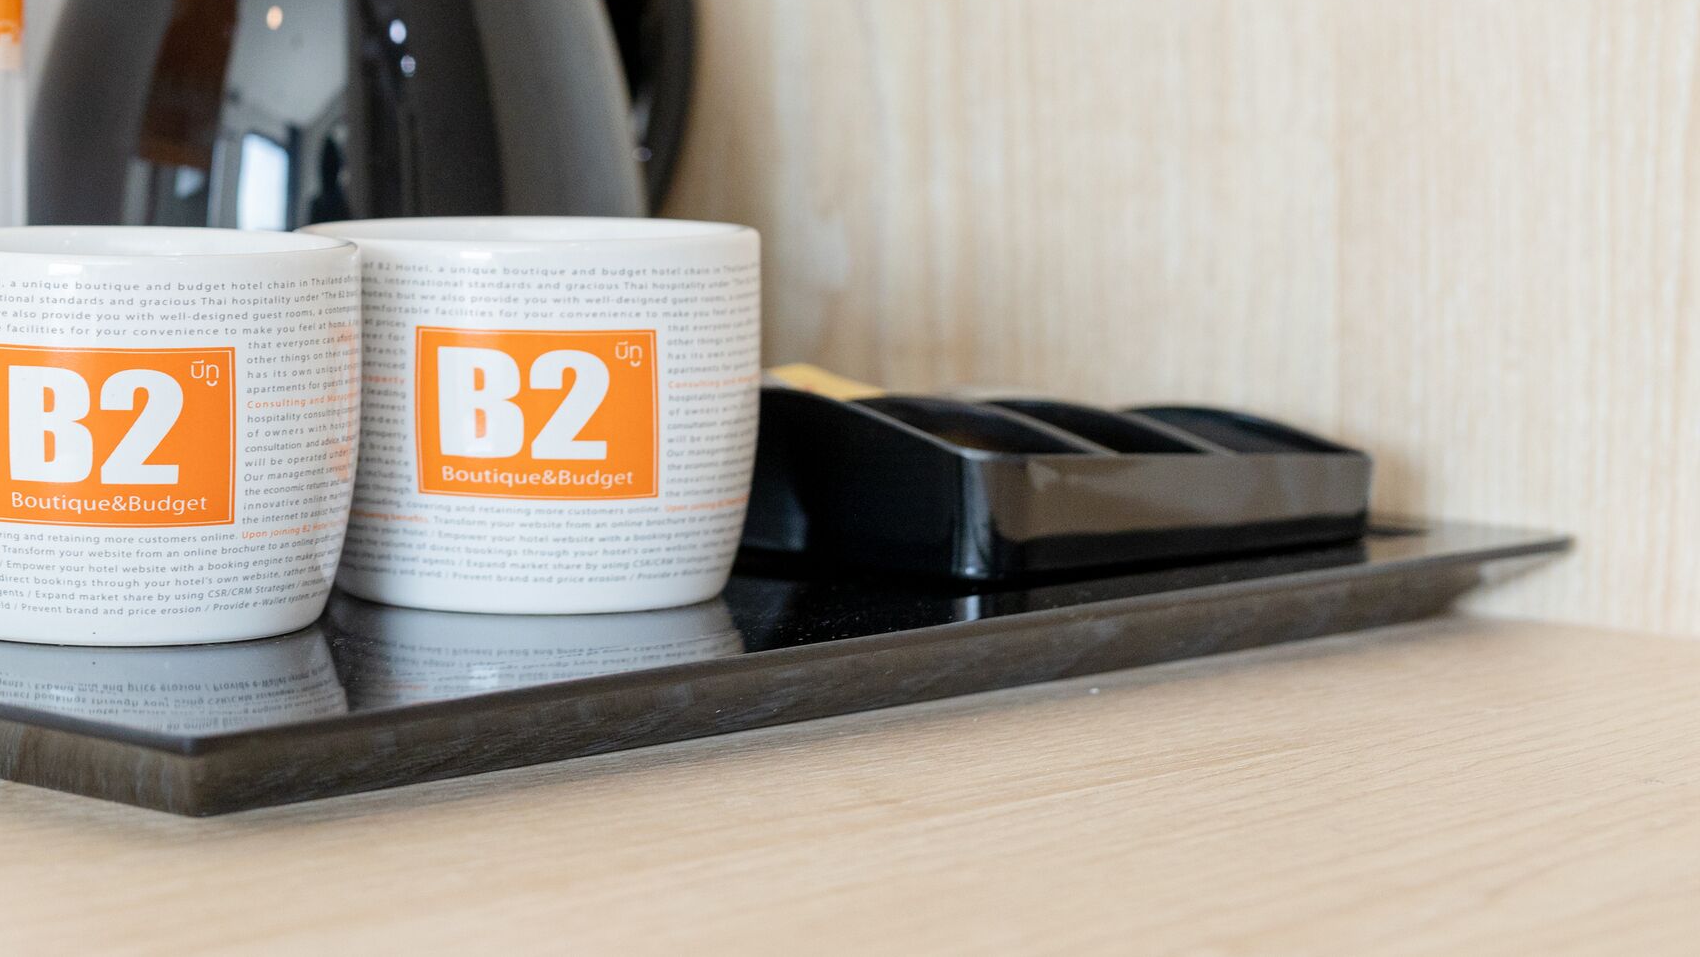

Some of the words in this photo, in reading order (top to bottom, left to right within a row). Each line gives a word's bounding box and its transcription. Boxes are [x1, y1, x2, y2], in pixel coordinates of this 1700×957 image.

[22, 280, 68, 291] unique
[75, 281, 140, 293] boutique
[146, 282, 172, 290] and
[177, 282, 226, 293] budget
[231, 280, 263, 290] hotel
[267, 280, 296, 289] chain
[299, 278, 308, 287] in
[39, 295, 104, 305] standards
[110, 297, 135, 306] and
[139, 297, 196, 308] gracious
[202, 296, 227, 305] Thai
[232, 295, 291, 307] hospitality
[294, 293, 319, 302] under
[12, 309, 37, 318] also
[42, 311, 92, 321] provide
[96, 314, 120, 323] you
[126, 312, 154, 321] with
[160, 311, 249, 322] well-designed
[252, 310, 282, 322] guest
[6, 323, 65, 334] facilities
[70, 326, 90, 335] for
[96, 329, 126, 338] your
[133, 327, 220, 336] convenience
[224, 326, 238, 335] to
[242, 325, 273, 335] make
[276, 326, 296, 336] you
[299, 322, 316, 331] feel
[248, 340, 272, 350] that
[276, 339, 321, 349] everyone
[247, 355, 276, 364] other
[281, 353, 311, 363] things
[615, 341, 642, 367] บีทู
[191, 360, 219, 386] บีทู
[248, 371, 271, 379] has
[273, 369, 288, 378] its
[247, 382, 306, 396] apartments
[247, 397, 306, 409] Consulting
[438, 346, 610, 460] B2
[9, 365, 183, 484] B2
[247, 412, 302, 425] hospitality
[245, 441, 302, 452] consultation
[245, 457, 265, 467] will
[270, 457, 283, 466] be
[287, 452, 328, 466] operated
[244, 473, 264, 482] Our
[267, 466, 325, 480] management
[442, 466, 633, 489] Boutique&Budget
[11, 492, 207, 515] Boutique&Budget
[243, 498, 300, 510] innovative
[242, 516, 259, 525] the
[262, 511, 299, 523] internet
[23, 532, 44, 541] and
[47, 534, 101, 546] retaining
[138, 535, 198, 544] customers
[200, 532, 238, 542] online.
[242, 531, 267, 541] Upon
[271, 527, 299, 539] joining
[3, 545, 56, 556] Transform
[58, 550, 84, 559] your
[88, 549, 133, 558] website
[136, 549, 163, 558] from
[183, 548, 218, 557] online
[221, 544, 266, 554] brochure
[268, 542, 278, 550] to
[6, 560, 56, 572] Empower
[59, 565, 84, 574] your
[88, 564, 118, 573] hotel
[122, 564, 167, 573] website
[170, 563, 195, 572] with
[207, 560, 250, 570] booking
[252, 556, 283, 568] engine
[34, 576, 87, 589] bookings
[92, 578, 140, 589] through
[144, 580, 171, 590] your
[175, 576, 213, 586] hotel's
[216, 576, 239, 584] own
[35, 590, 76, 602] Expand
[79, 592, 119, 601] market
[123, 593, 154, 601] share
[157, 593, 171, 603] by
[174, 591, 205, 602] using
[21, 602, 64, 613] Prevent
[66, 606, 99, 615] brand
[103, 607, 126, 615] and
[128, 607, 157, 618] price
[158, 605, 202, 615] erosion
[213, 600, 250, 611] Provide
